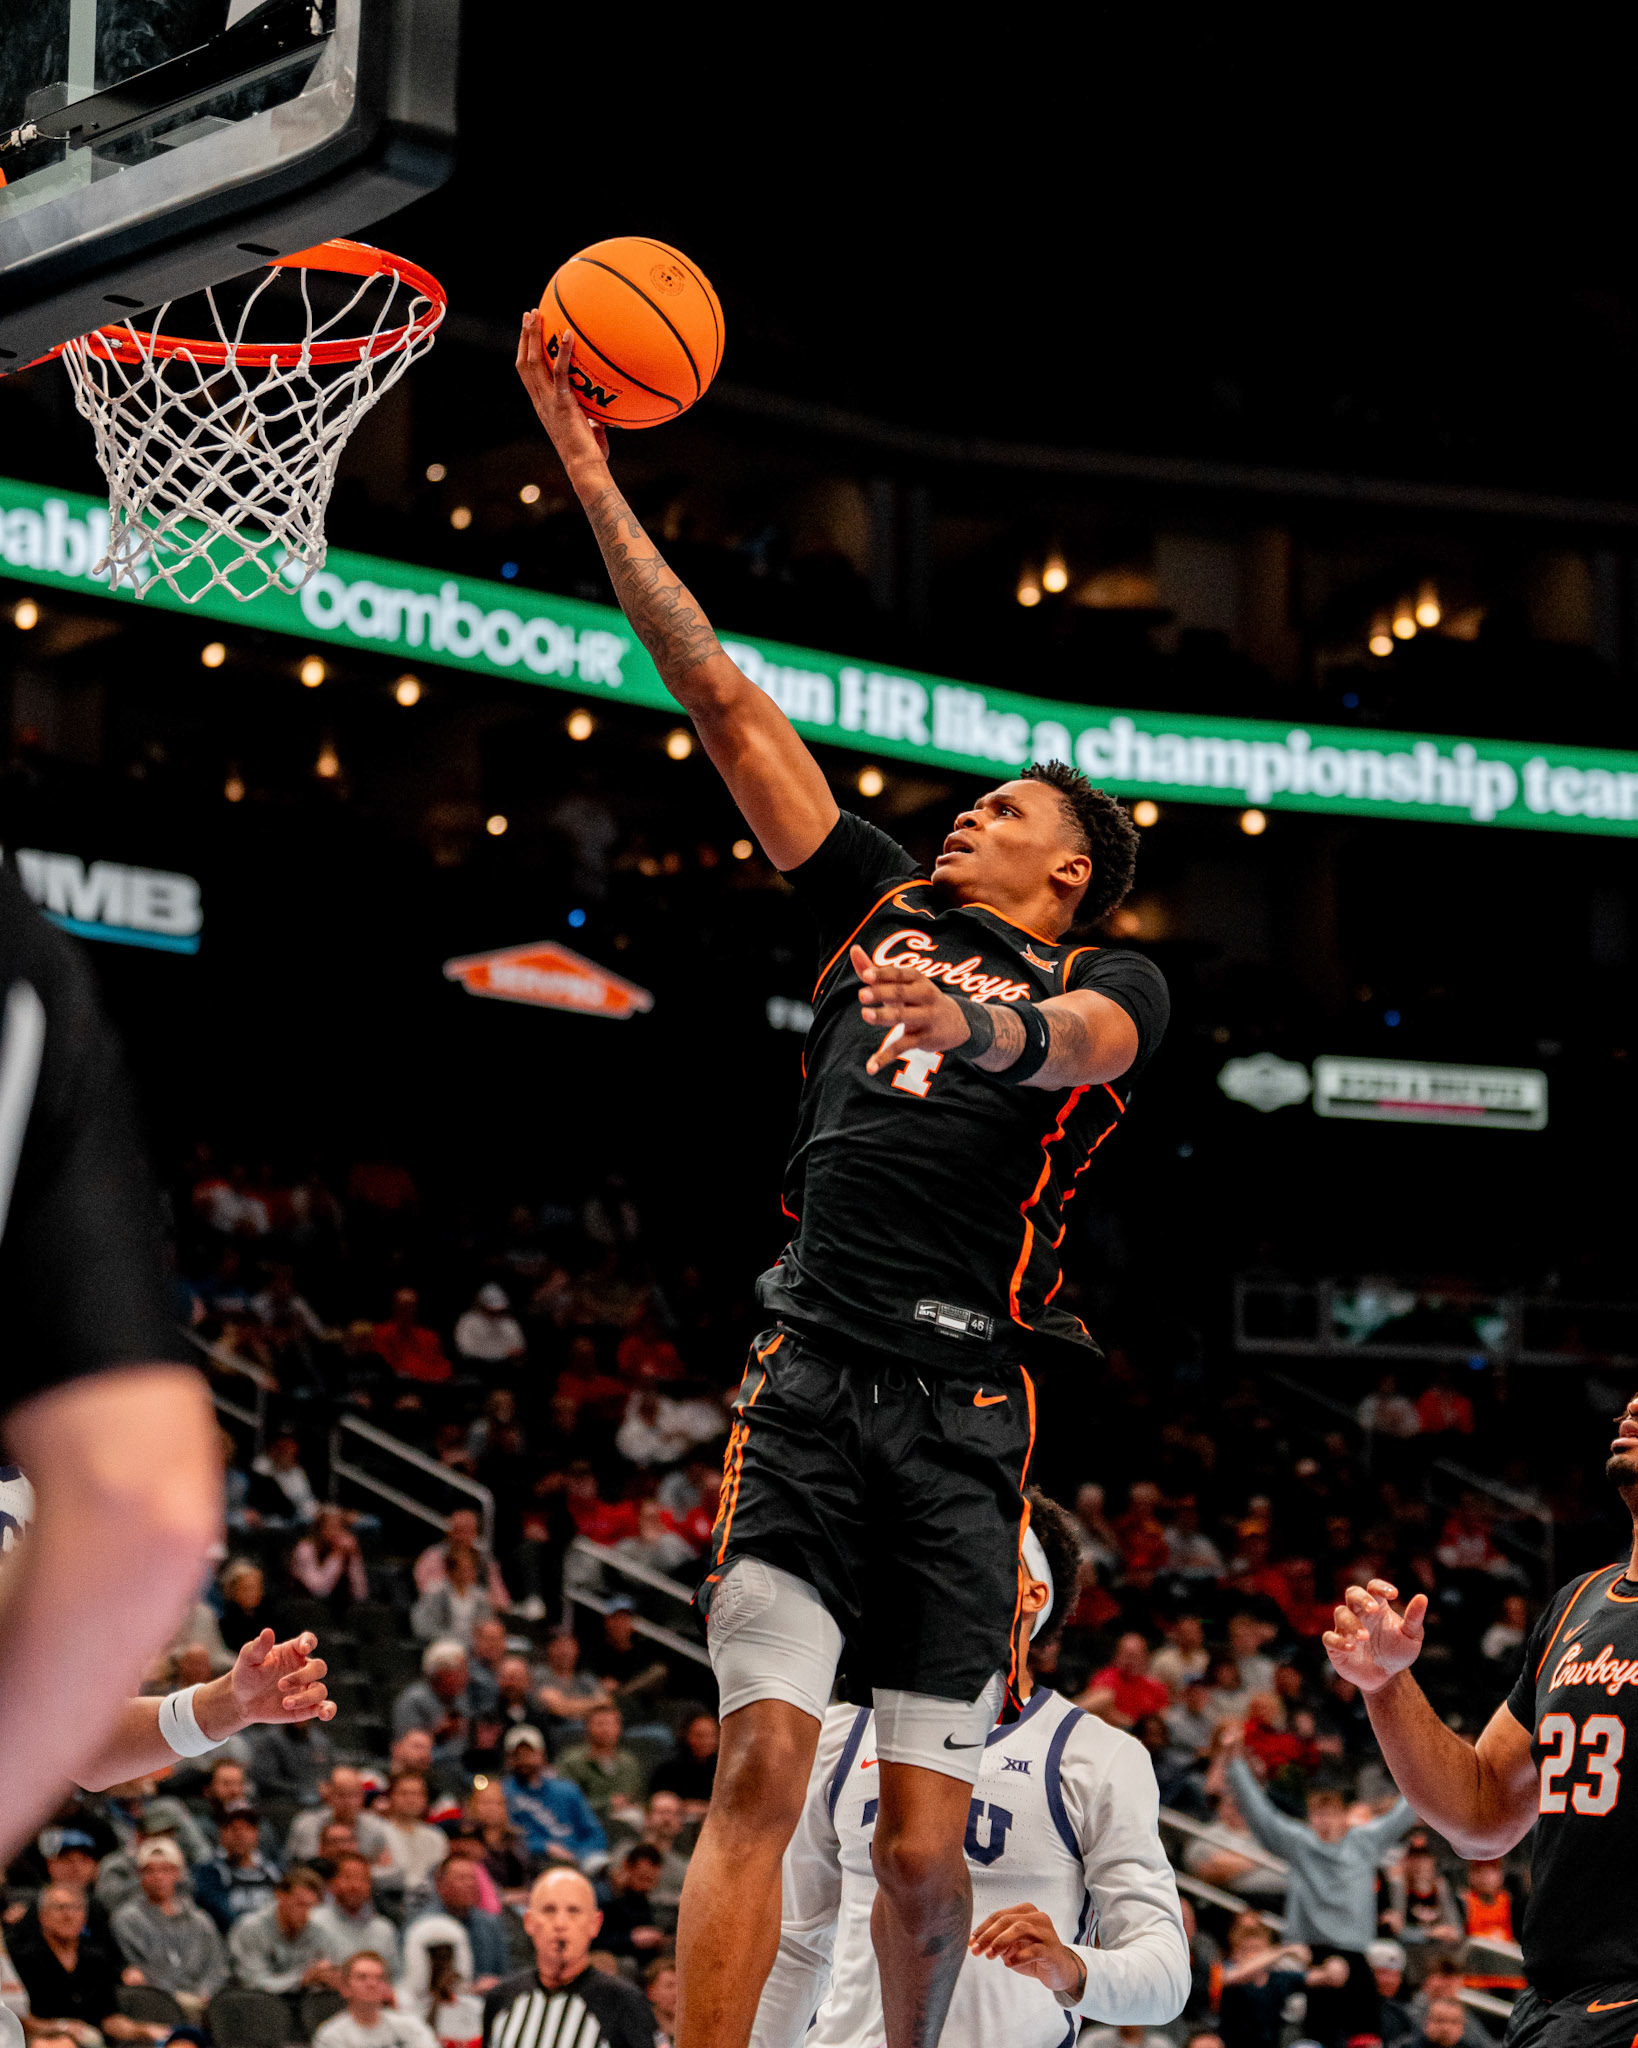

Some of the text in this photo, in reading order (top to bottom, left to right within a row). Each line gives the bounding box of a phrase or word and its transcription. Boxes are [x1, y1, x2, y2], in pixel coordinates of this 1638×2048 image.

[546, 334, 619, 408] NCA
[0, 498, 150, 589] able
[838, 667, 931, 746] HR
[931, 685, 1031, 765] like
[1074, 717, 1519, 821] championship
[872, 929, 1031, 1004] Cowboys
[971, 1319, 984, 1331] 46
[1539, 1712, 1626, 1817] 23
